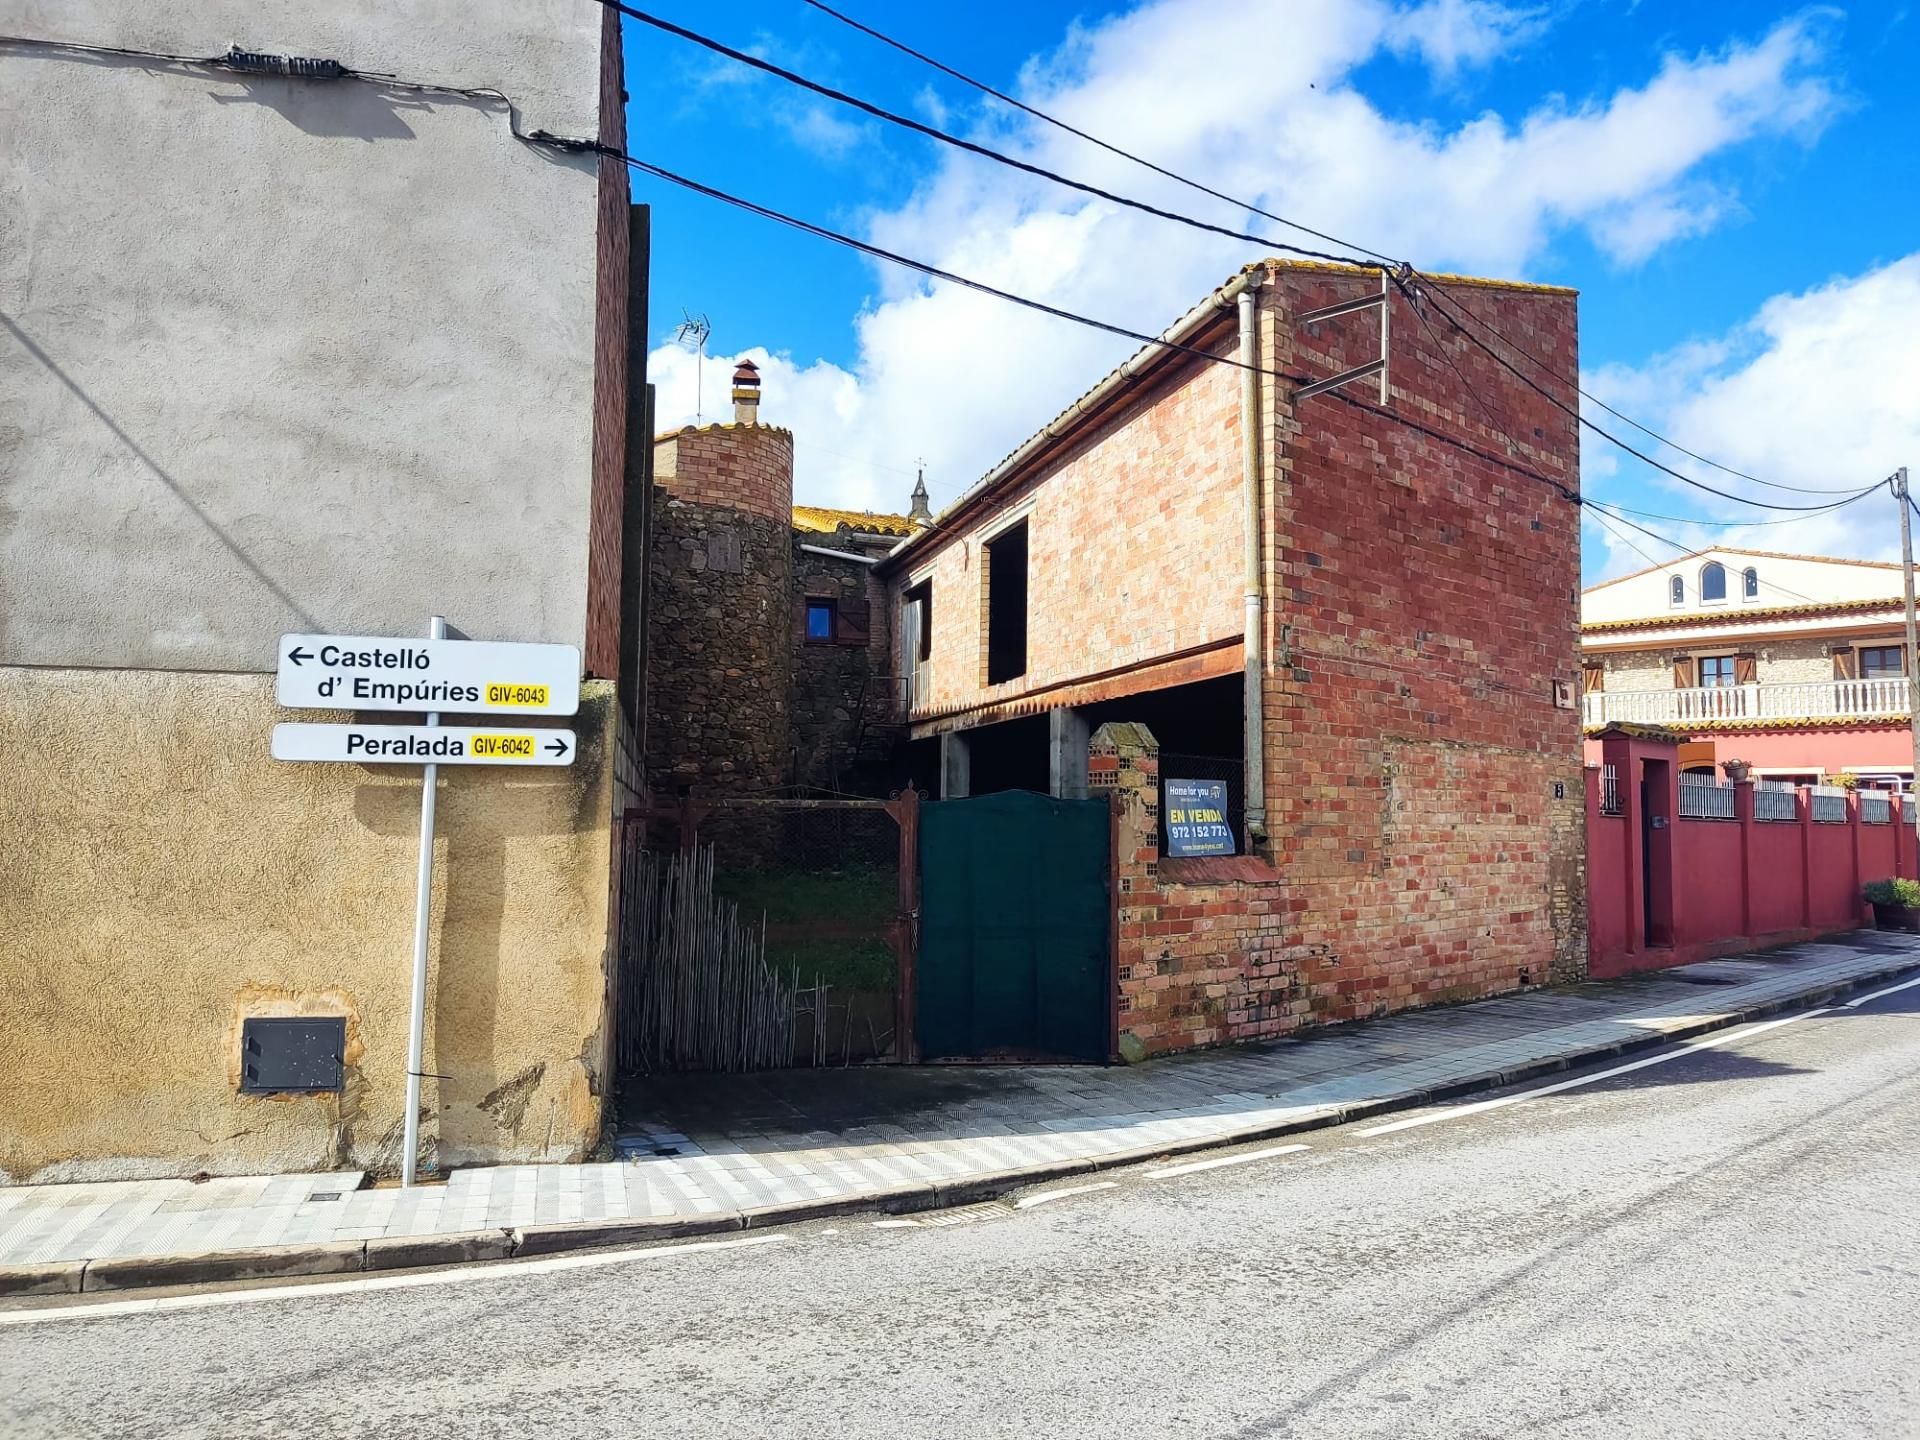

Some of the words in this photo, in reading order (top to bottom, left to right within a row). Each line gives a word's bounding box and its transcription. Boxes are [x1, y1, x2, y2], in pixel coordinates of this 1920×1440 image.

[320, 645, 430, 670] Castelló
[353, 677, 479, 704] Empúries
[489, 685, 546, 704] GIV-6043
[346, 733, 464, 757] Peralada
[473, 737, 531, 756] GIV-6042
[1169, 786, 1187, 796] Home
[1187, 786, 1196, 796] for
[1197, 788, 1209, 798] you
[1170, 809, 1185, 823] EN
[1188, 808, 1224, 823] VENDA
[1172, 826, 1190, 839] 972
[1192, 825, 1209, 837] 152
